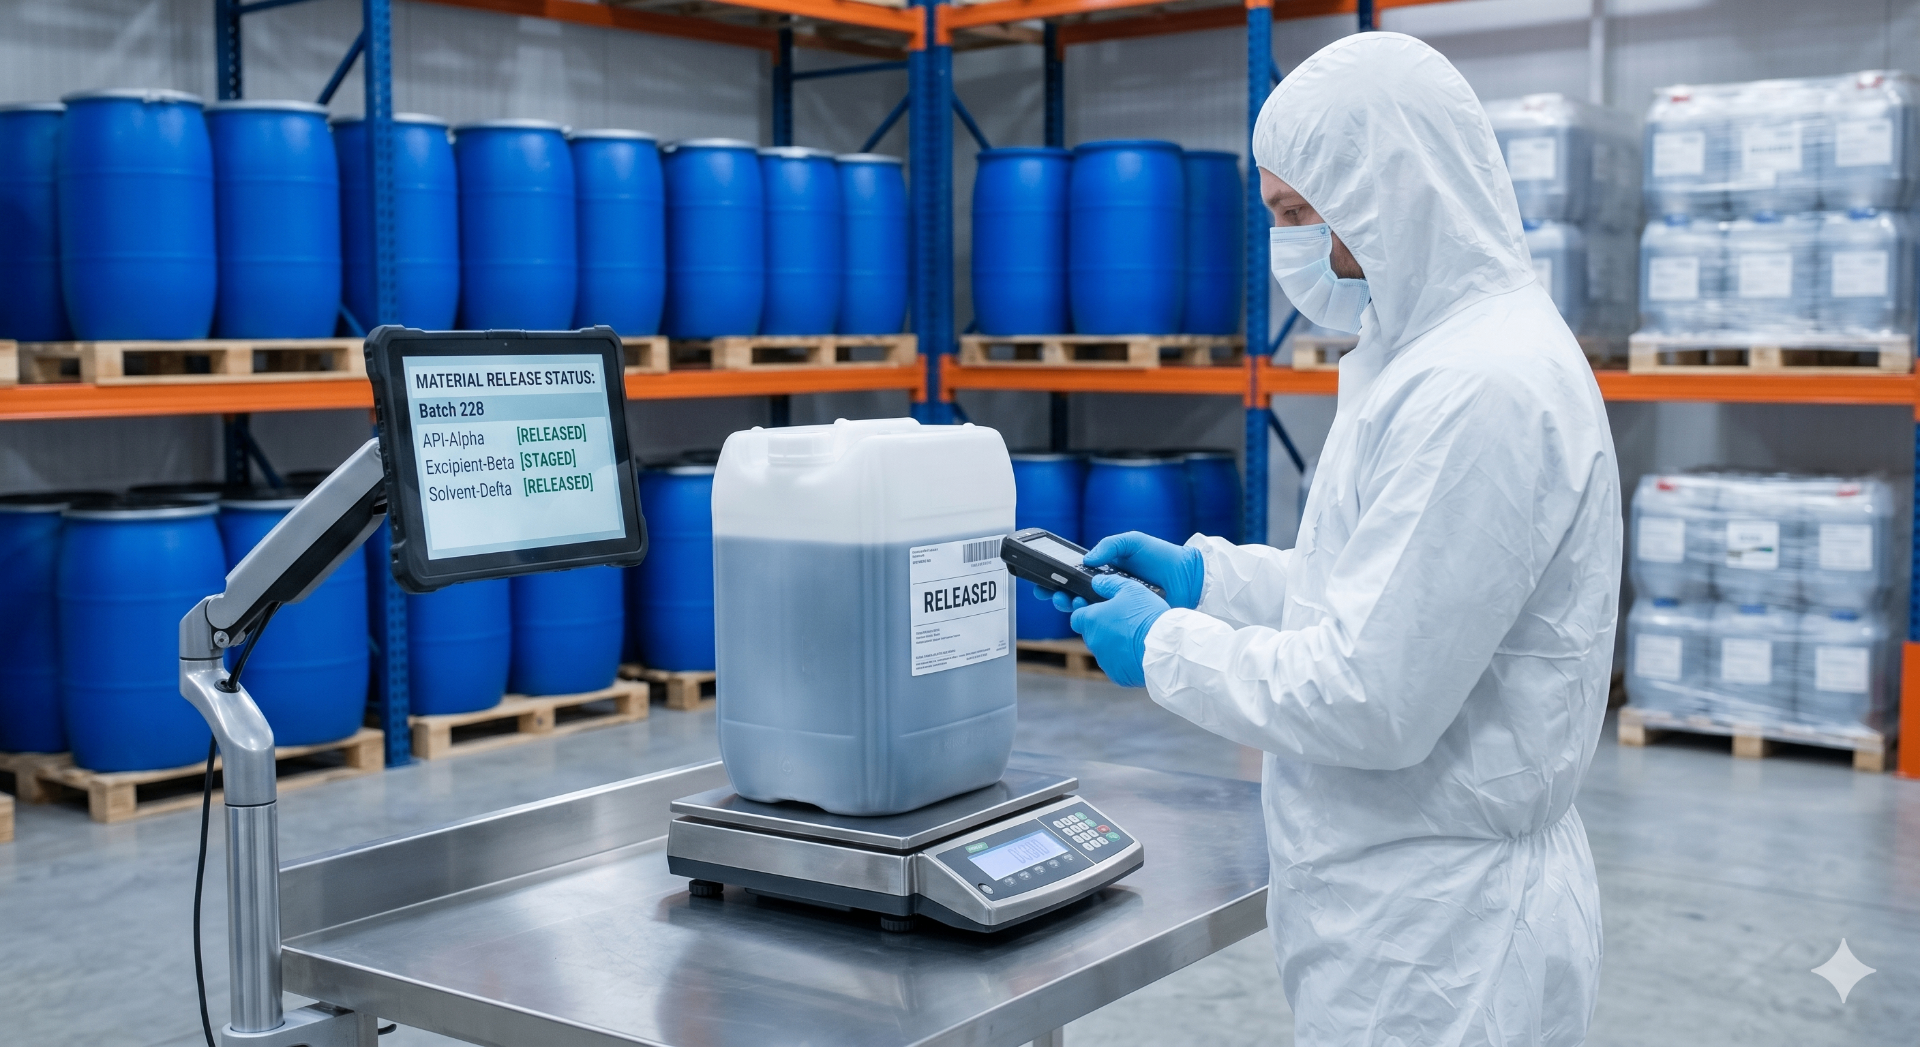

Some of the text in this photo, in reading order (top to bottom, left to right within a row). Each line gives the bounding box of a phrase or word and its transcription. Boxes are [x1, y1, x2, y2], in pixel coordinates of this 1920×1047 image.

[415, 369, 596, 389] MATERIAL RELEASE STATUS:
[419, 401, 485, 419] Batch 228
[422, 423, 587, 450] API-Alpha [RELEASED]
[425, 448, 577, 477] Excipient-Beta [STAGED]
[523, 472, 594, 497] [RELEASED]
[924, 580, 997, 613] RELEASED
